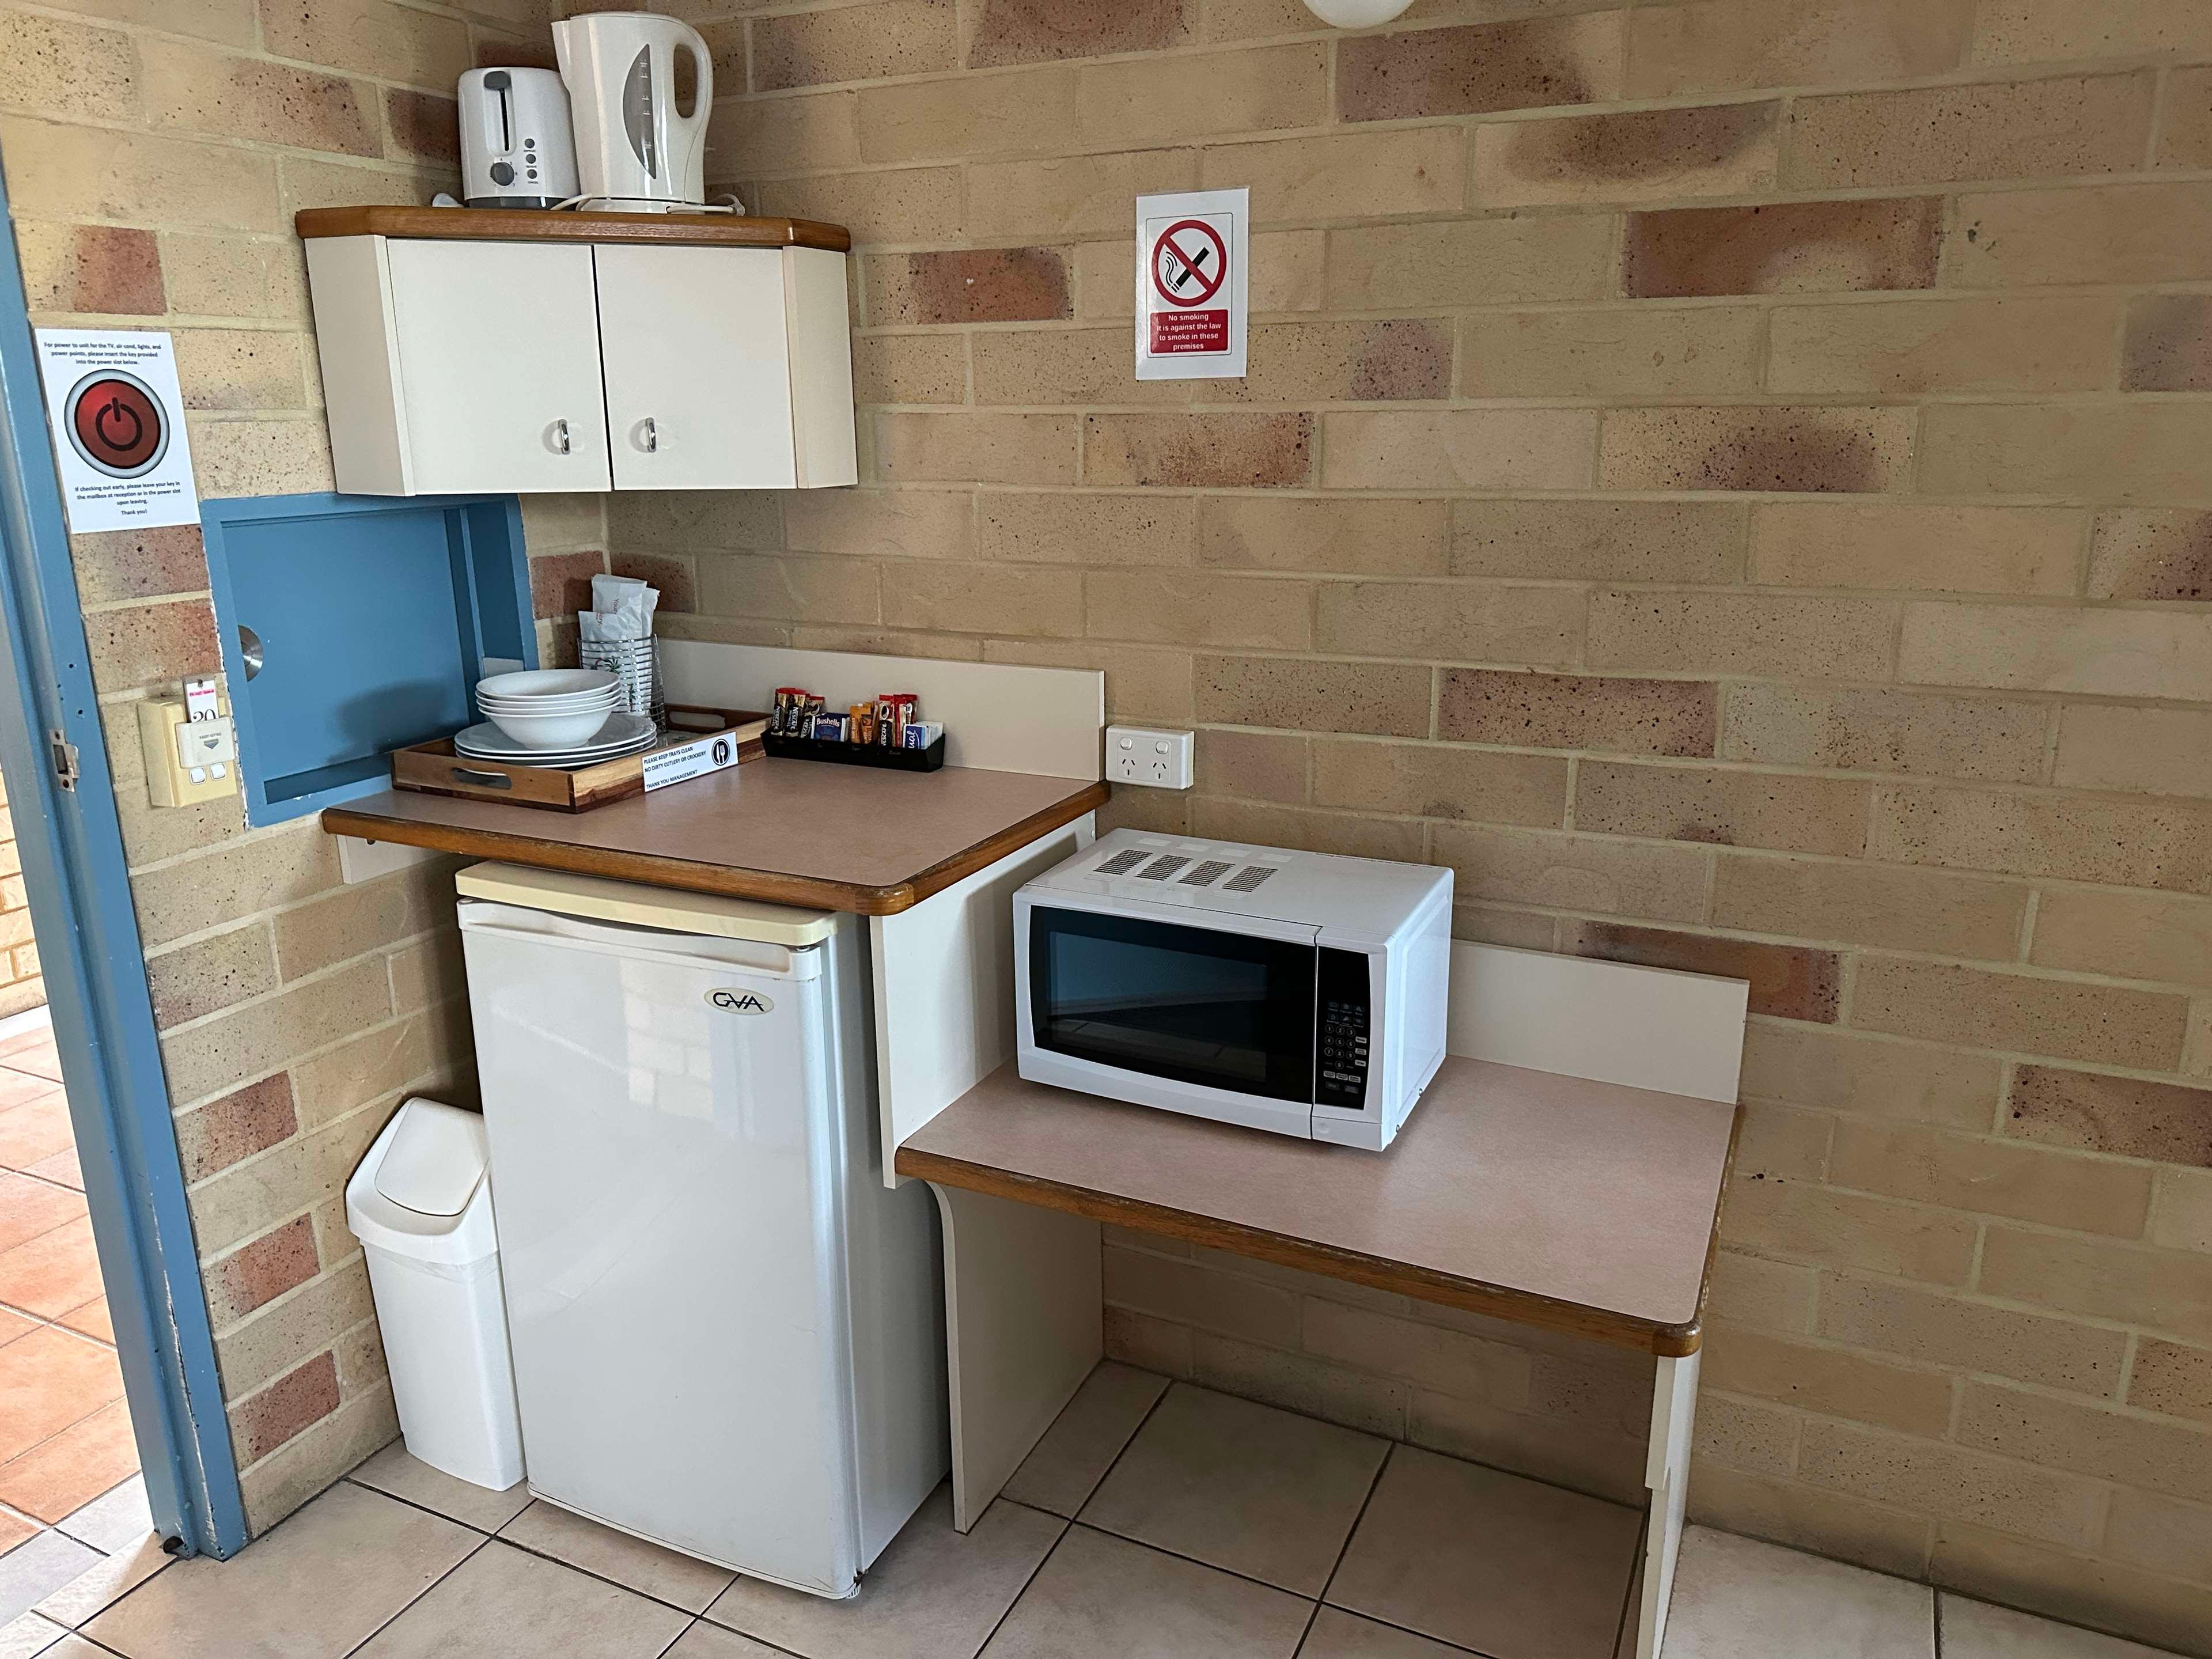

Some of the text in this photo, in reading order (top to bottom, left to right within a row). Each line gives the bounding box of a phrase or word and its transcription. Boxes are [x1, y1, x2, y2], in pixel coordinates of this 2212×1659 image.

[1171, 324, 1195, 332] against
[1173, 343, 1204, 351] premises
[194, 709, 217, 722] 20
[816, 717, 840, 727] Bushells
[644, 756, 658, 764] PLEASE
[664, 758, 680, 767] CUTLERY
[687, 751, 706, 760] CROCKERY
[670, 770, 698, 781] MANAGEMENT
[713, 992, 764, 1012] GVA
